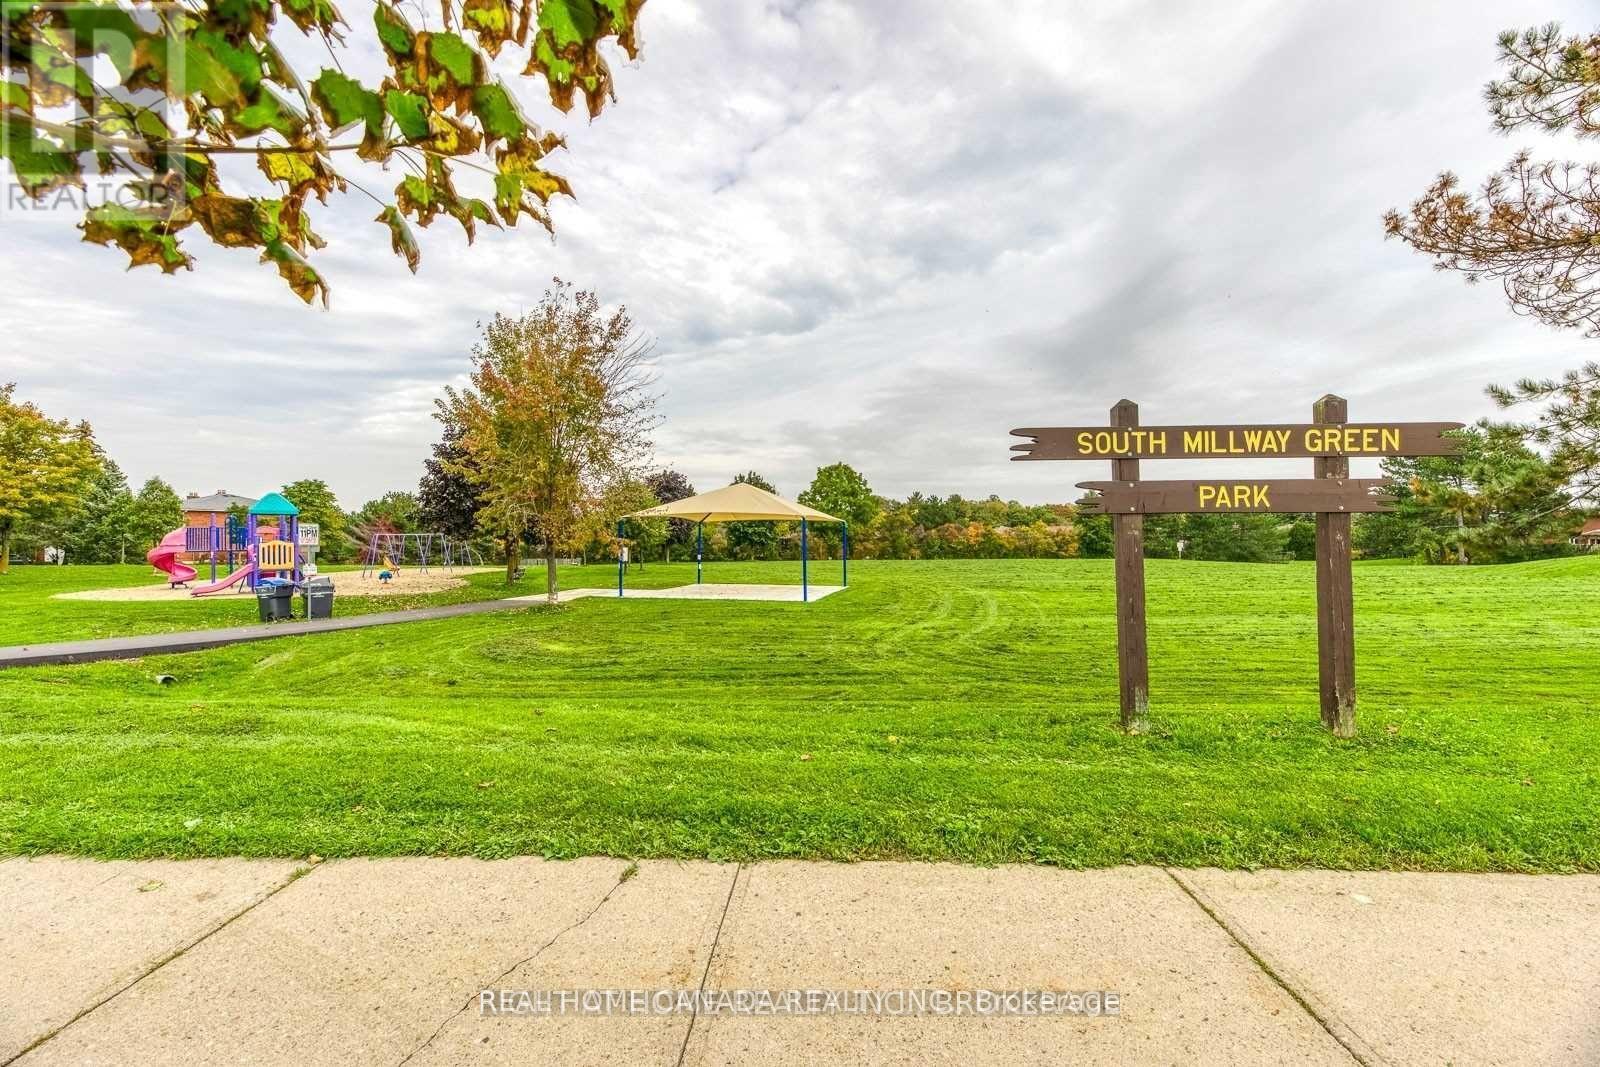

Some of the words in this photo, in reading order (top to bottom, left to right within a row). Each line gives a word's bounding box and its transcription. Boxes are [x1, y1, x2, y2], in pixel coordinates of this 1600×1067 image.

[1077, 430, 1167, 455] SOUTH
[1183, 429, 1292, 454] MILLWAY
[1304, 428, 1400, 453] GREEN
[1199, 485, 1271, 508] PARK
